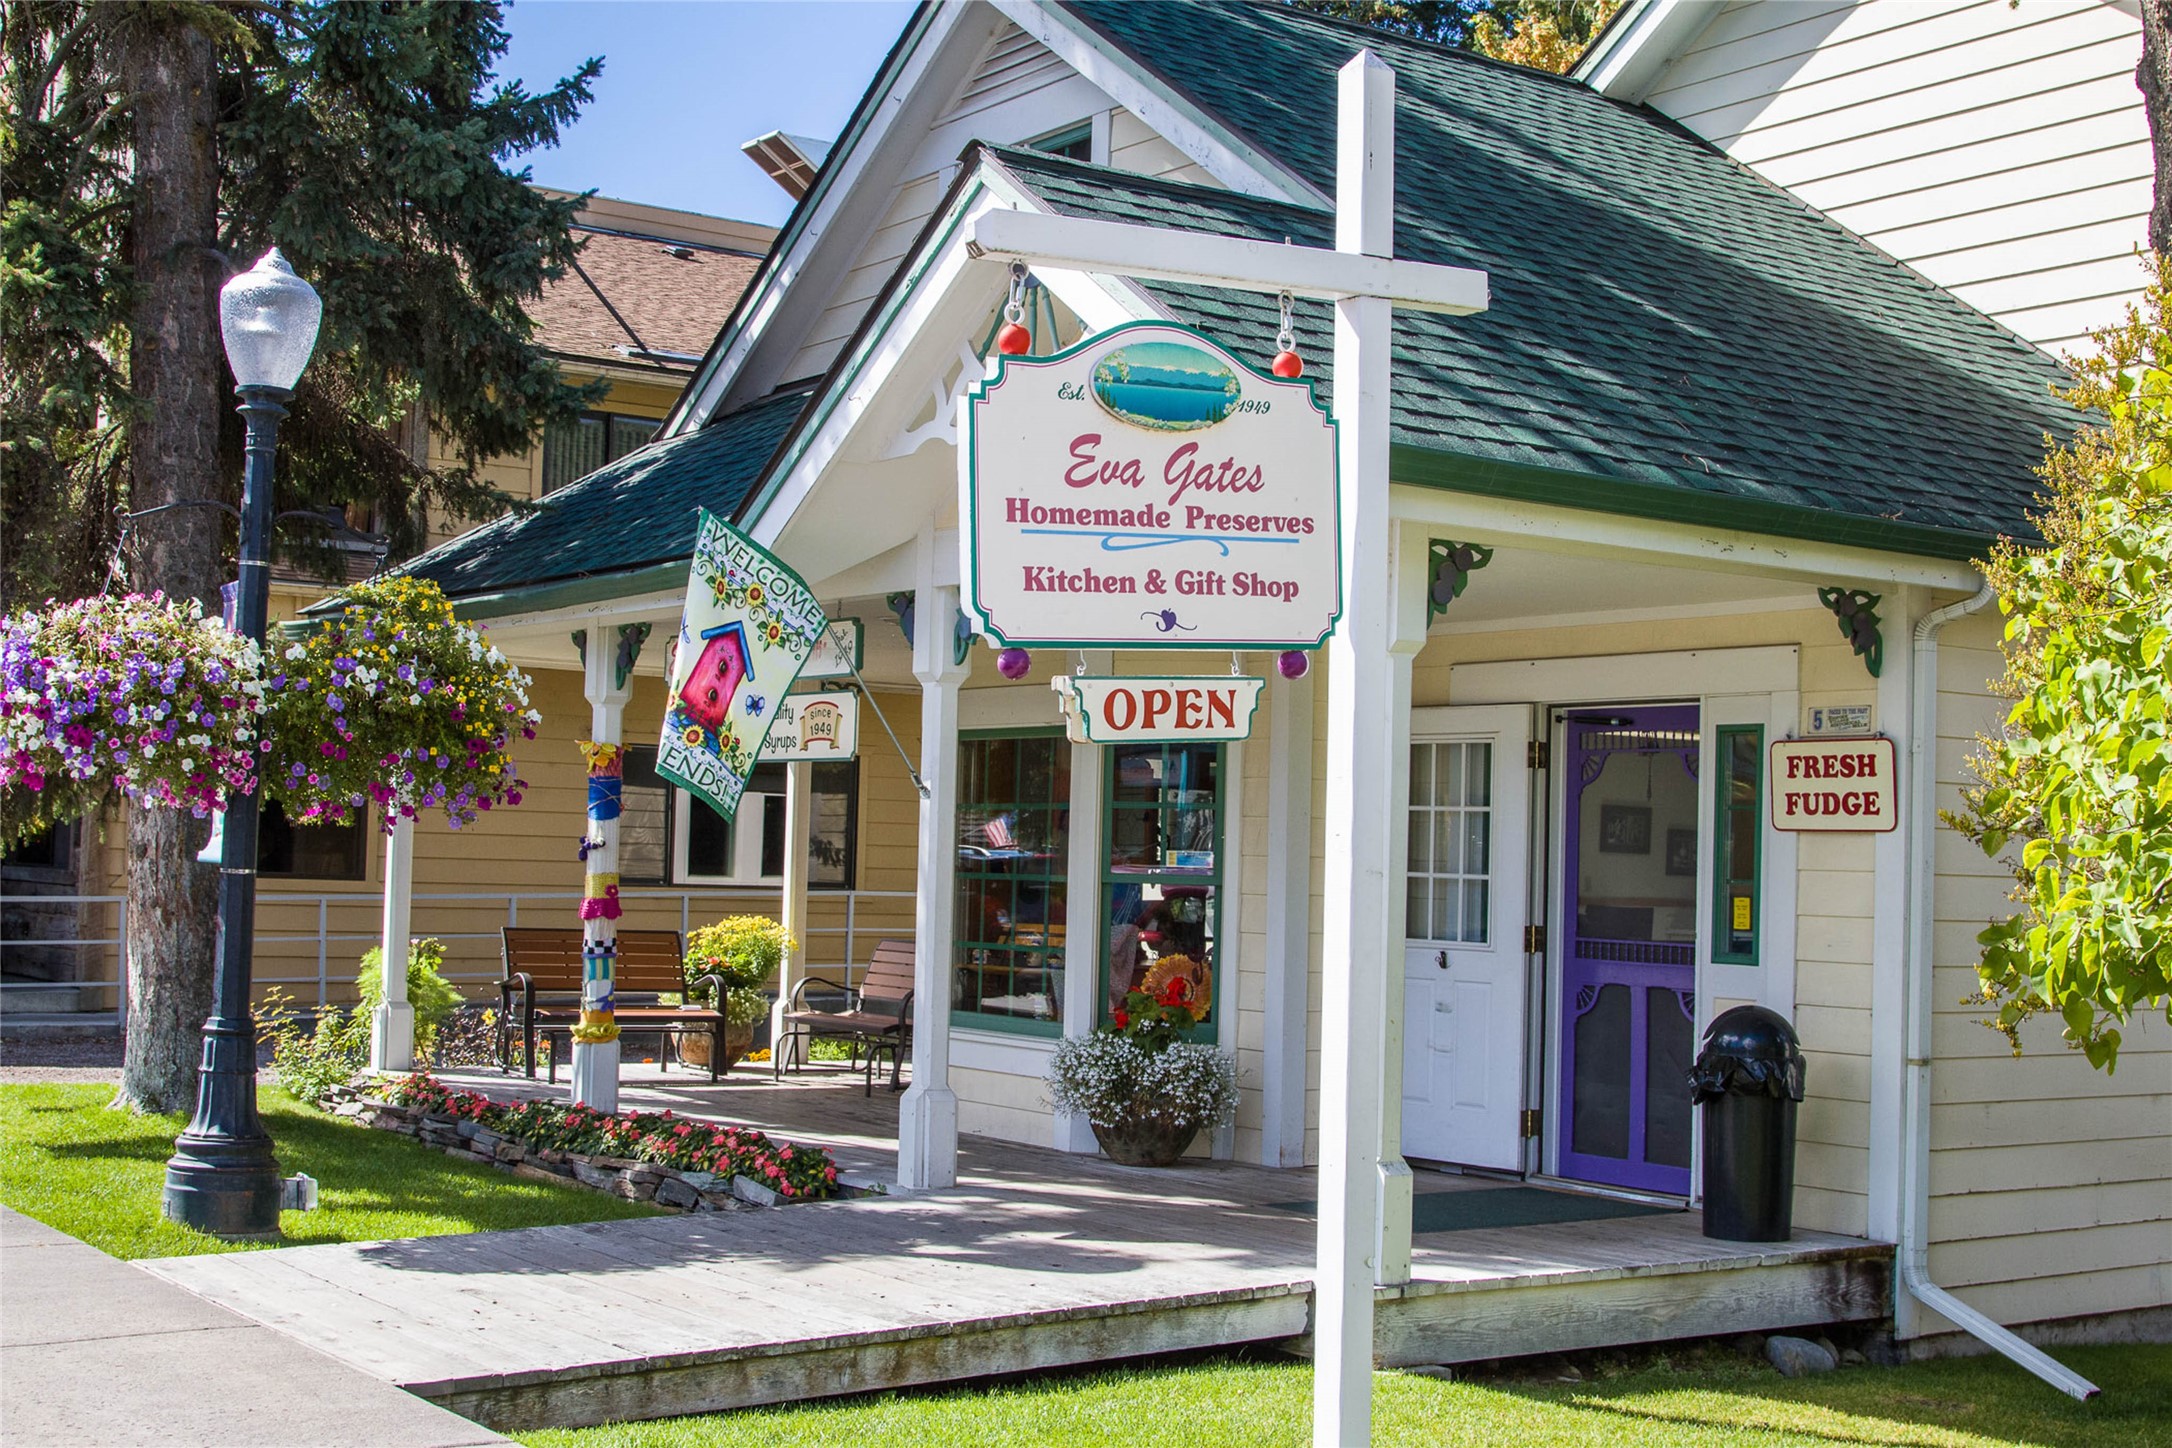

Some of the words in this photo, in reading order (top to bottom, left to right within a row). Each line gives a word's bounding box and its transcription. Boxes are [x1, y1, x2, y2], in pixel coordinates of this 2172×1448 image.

[1058, 381, 1085, 401] Est.
[1238, 400, 1271, 415] 1949
[1064, 433, 1145, 489] Eva
[1164, 441, 1265, 506] Gates
[1005, 497, 1171, 529] Homemade
[1185, 505, 1315, 534] Preserves
[712, 522, 822, 626] WELCOME
[1022, 565, 1137, 594] Kitchen
[1144, 568, 1167, 595] &
[1175, 570, 1226, 596] Gift
[1232, 572, 1300, 603] Shop
[810, 708, 832, 720] since
[1103, 688, 1237, 731] OPEN
[1813, 710, 1823, 731] 5
[810, 722, 832, 736] 1949
[764, 732, 797, 754] Syrups
[1786, 754, 1878, 779] FRESH
[1785, 791, 1881, 816] FUDGE
